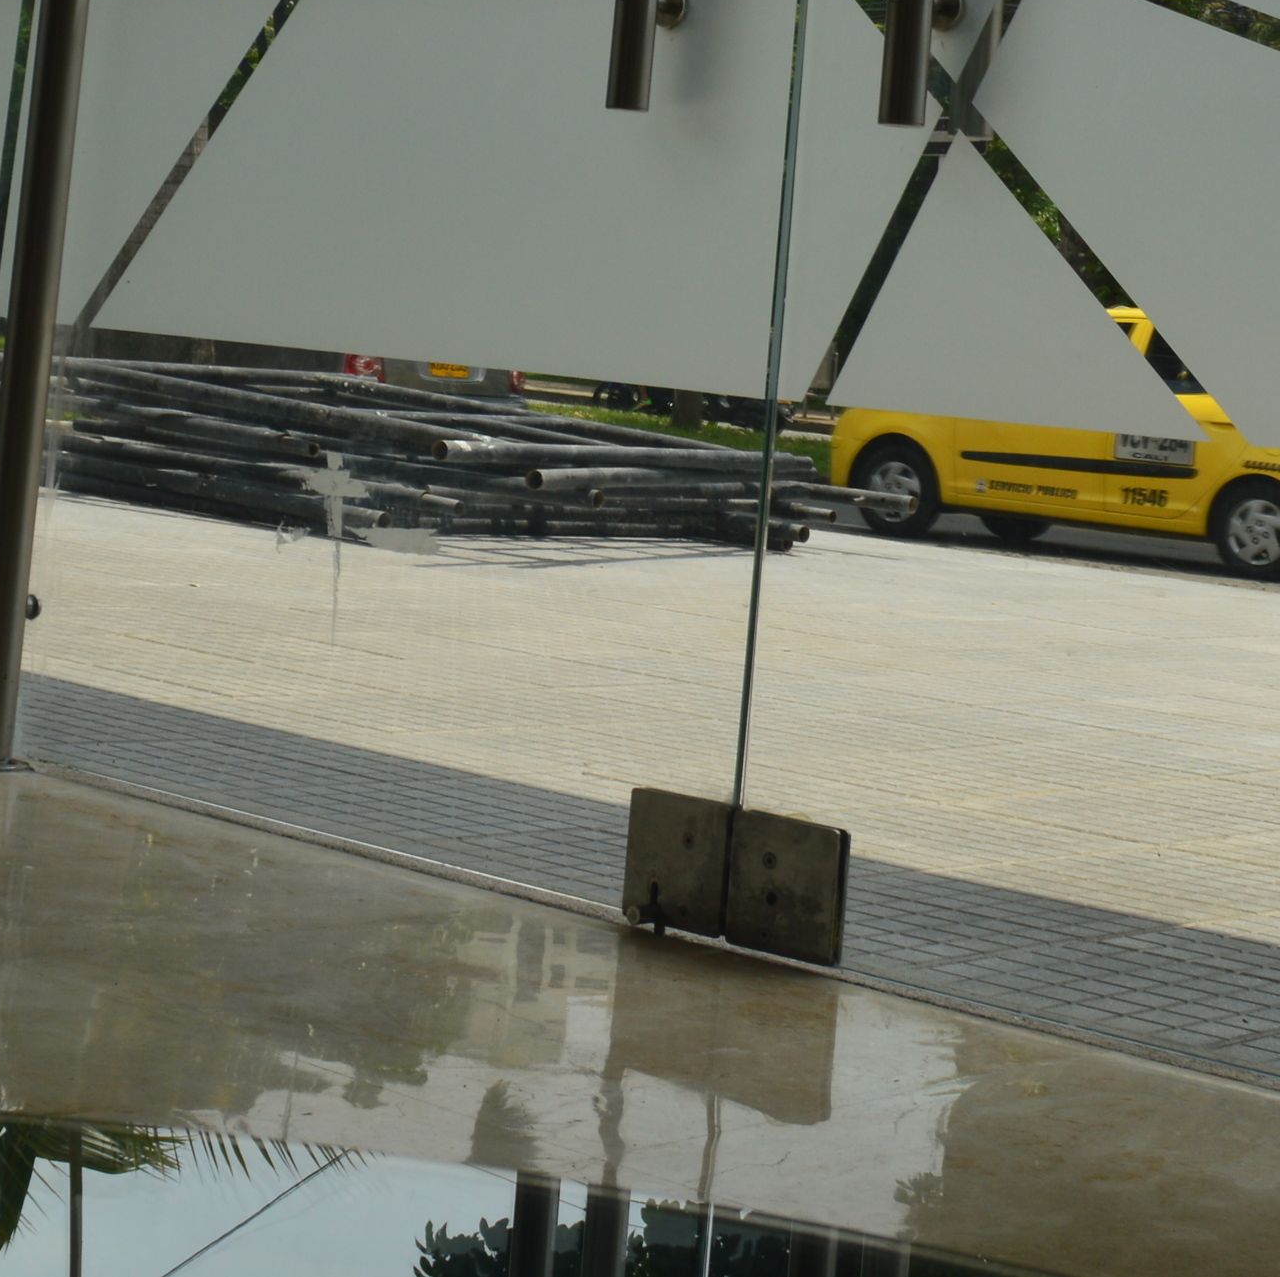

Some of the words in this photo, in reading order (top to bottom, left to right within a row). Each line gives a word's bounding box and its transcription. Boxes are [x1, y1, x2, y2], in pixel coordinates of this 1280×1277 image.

[1131, 452, 1169, 462] CALI
[988, 480, 1032, 495] SERVICIO
[1121, 486, 1169, 508] 11546
